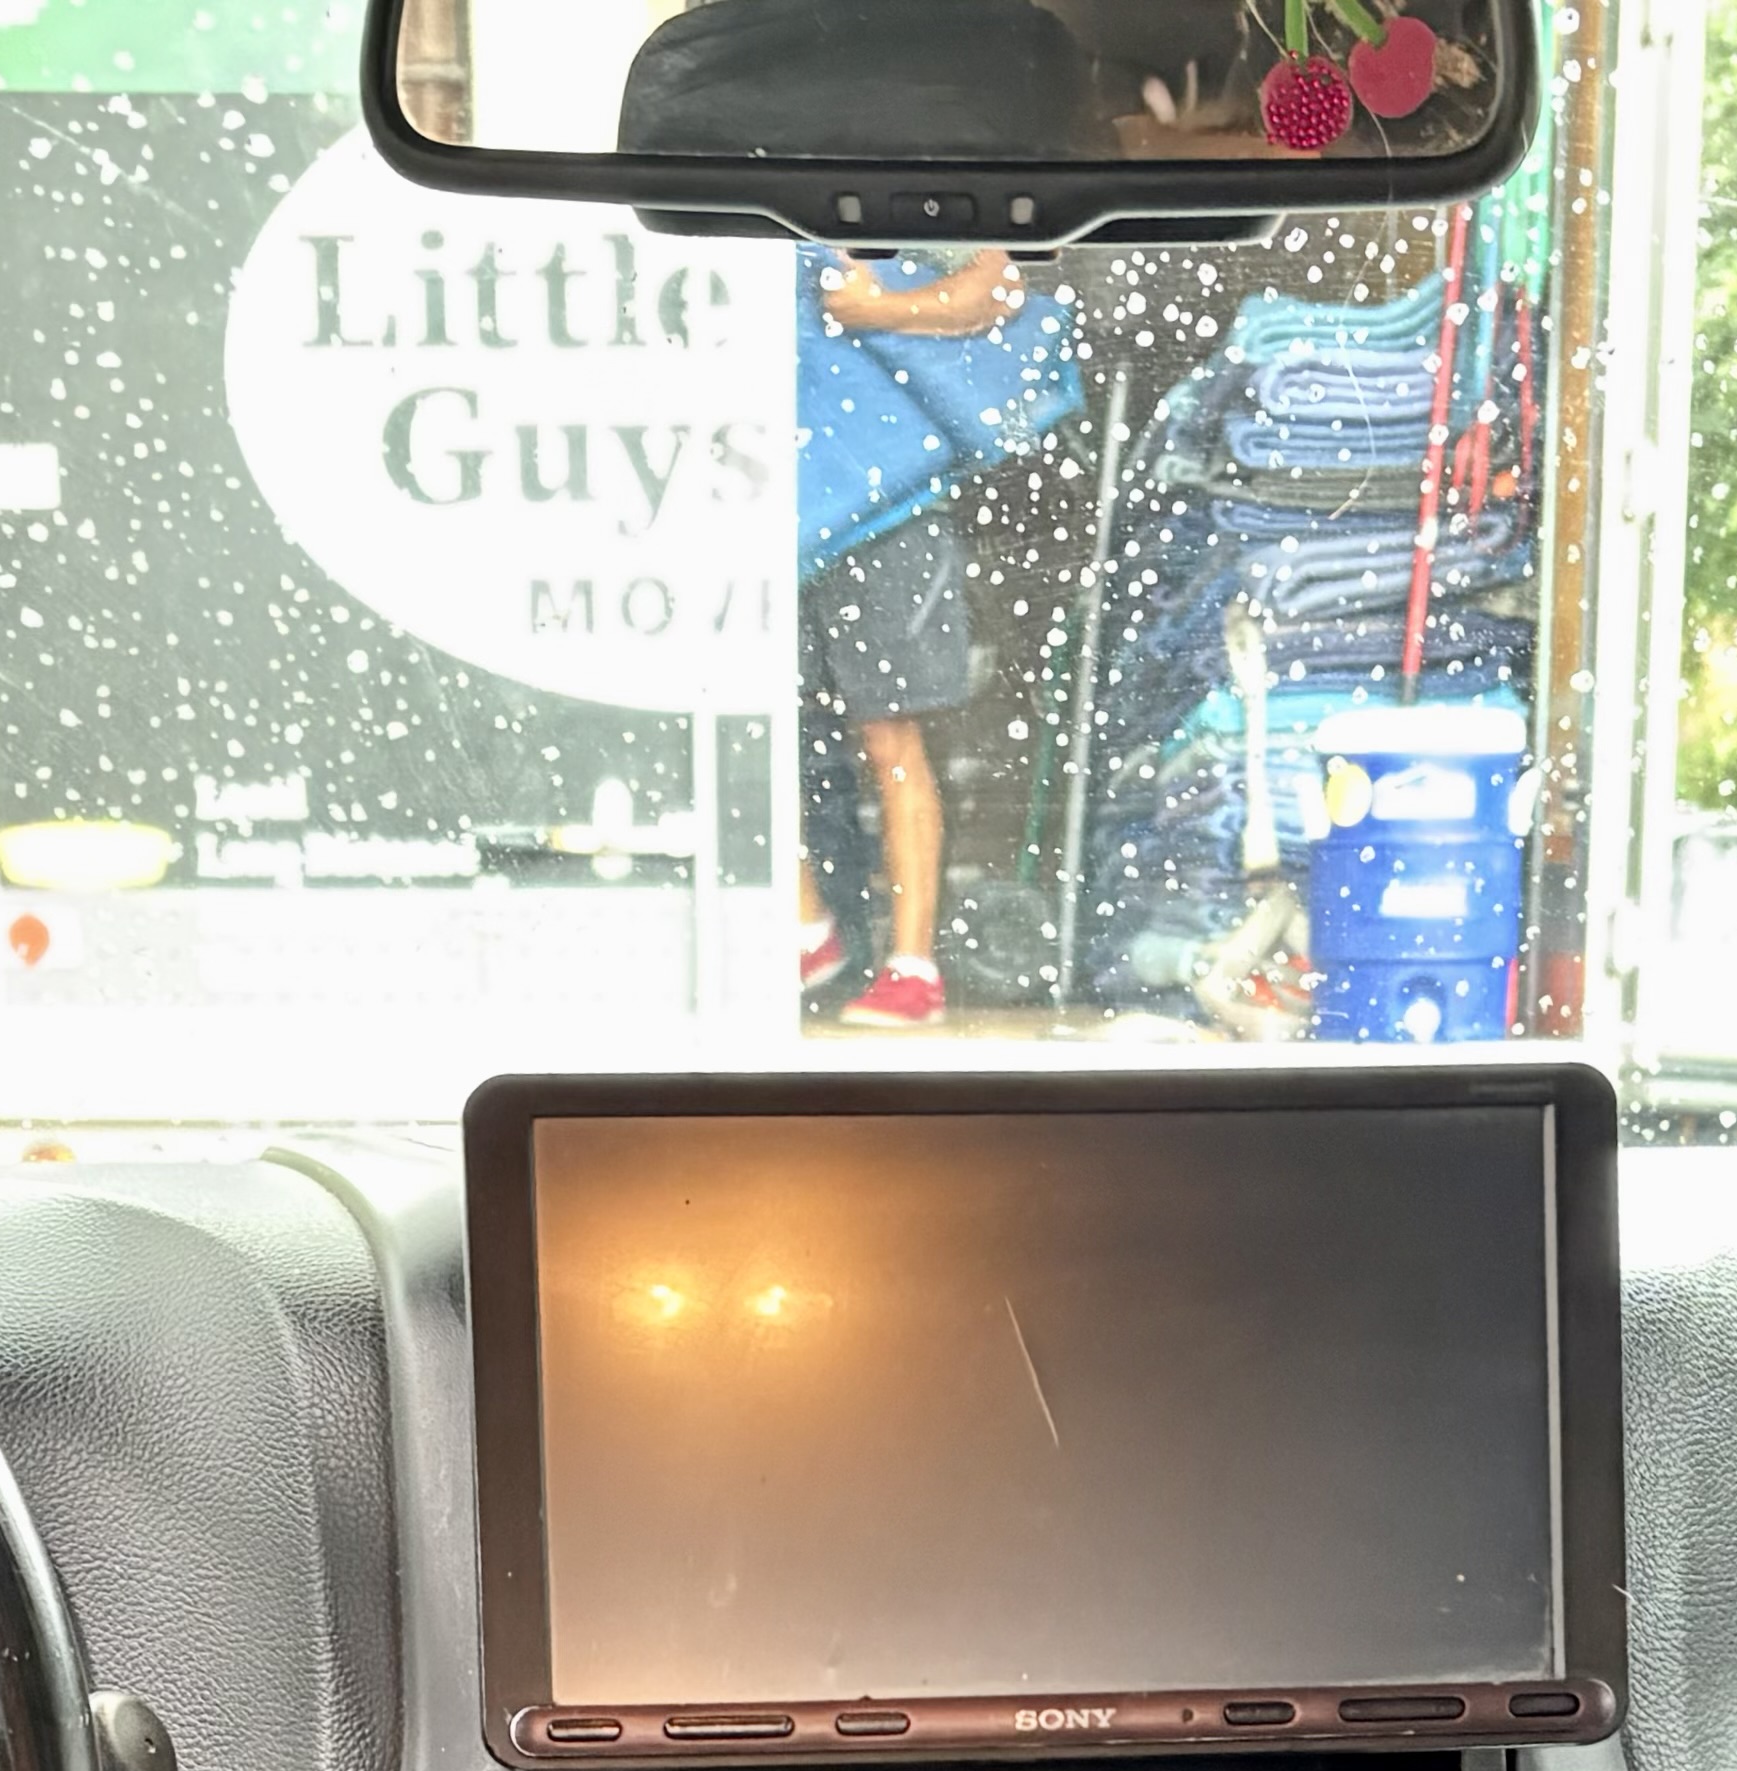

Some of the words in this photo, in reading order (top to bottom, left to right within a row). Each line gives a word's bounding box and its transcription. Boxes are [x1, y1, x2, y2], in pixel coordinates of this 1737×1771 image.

[299, 229, 732, 349] Little
[381, 386, 771, 537] Guys
[1014, 1706, 1117, 1732] SONY
